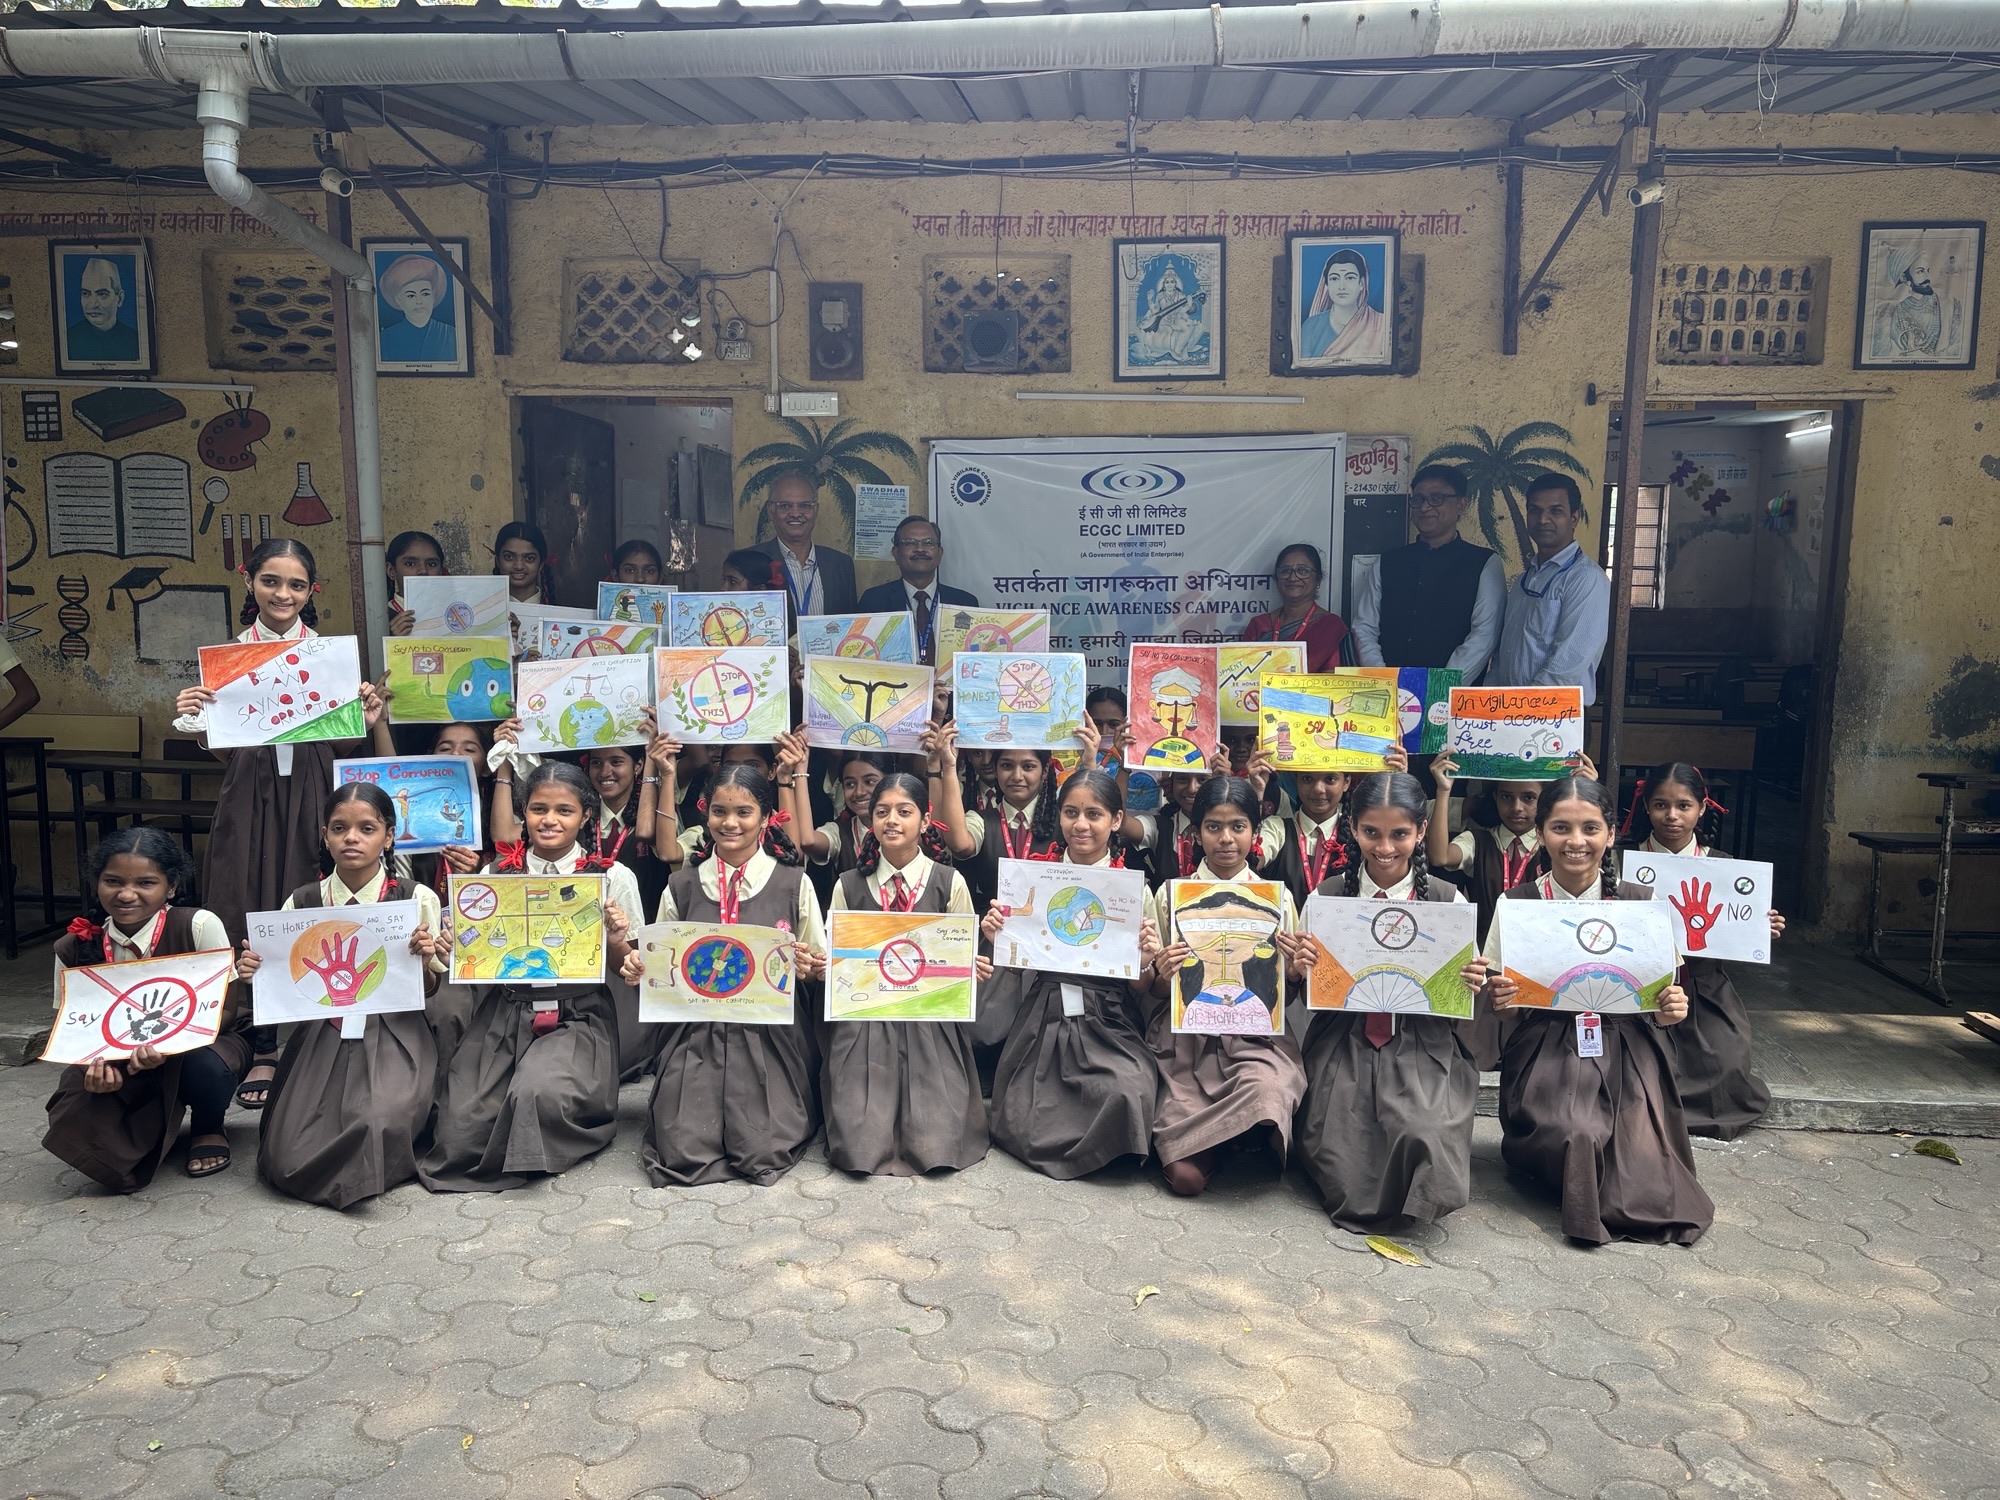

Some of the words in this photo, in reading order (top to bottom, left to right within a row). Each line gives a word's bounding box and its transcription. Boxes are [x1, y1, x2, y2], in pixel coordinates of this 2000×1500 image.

[957, 209, 971, 240] ती
[1024, 210, 1044, 238] जी
[1170, 215, 1208, 238] स्वप्न
[1212, 209, 1229, 237] ती
[1292, 209, 1313, 232] जी
[1398, 209, 1417, 239] देत
[952, 467, 980, 481] VIGILANCE
[950, 483, 964, 507] CENTRAL
[979, 471, 992, 506] COMMISSION
[1079, 505, 1087, 520] ई
[1090, 505, 1104, 519] सी
[1107, 505, 1122, 519] जी
[1126, 504, 1140, 518] सी
[1144, 504, 1187, 518] लिमिटेड
[1079, 524, 1122, 536] ECGC
[1126, 524, 1185, 536] LIMITED
[1098, 541, 1116, 549] (भारत
[1150, 551, 1184, 559] Enterprise)
[993, 569, 1069, 593] सतर्कता
[1074, 576, 1178, 593] जागरूकता
[1185, 568, 1273, 591] अभियान
[1084, 601, 1180, 615] AWARENESS
[1185, 600, 1269, 614] CAMPAIGN
[595, 641, 614, 651] STOP
[846, 642, 861, 653] STOP
[1079, 631, 1127, 650] हमारी
[394, 645, 408, 654] Say
[1139, 650, 1150, 658] SAY
[1152, 651, 1160, 659] NO
[1162, 652, 1169, 660] TO
[248, 667, 269, 686] BE
[275, 638, 333, 673] HONEST
[1013, 663, 1036, 673] STOP
[1086, 656, 1102, 667] ur
[1106, 656, 1128, 667] Sha
[721, 672, 742, 681] STOP
[961, 662, 981, 679] BE
[272, 670, 309, 690] AND
[1293, 679, 1320, 688] STOP
[298, 690, 321, 702] TO
[957, 691, 996, 703] HONEST
[1457, 694, 1475, 711] In
[1016, 700, 1039, 709] THIS
[258, 697, 346, 731] CORRUPTION
[701, 709, 724, 717] THIS
[1305, 720, 1326, 734] SAY
[1343, 720, 1358, 732] NO
[1452, 713, 1497, 731] trust
[1454, 730, 1492, 749] free
[344, 768, 380, 784] Stop
[389, 765, 454, 780] Corruption
[1108, 896, 1117, 906] Say
[1727, 902, 1752, 921] NO
[388, 915, 404, 923] SAY
[1188, 921, 1258, 930] JUSTICE
[255, 924, 274, 938] BE
[283, 919, 318, 934] HONEST
[936, 928, 948, 936] Say
[384, 933, 412, 941] CORRUPTI
[1319, 975, 1343, 994] INDIA
[66, 1012, 101, 1027] Say
[1187, 1008, 1200, 1026] BE
